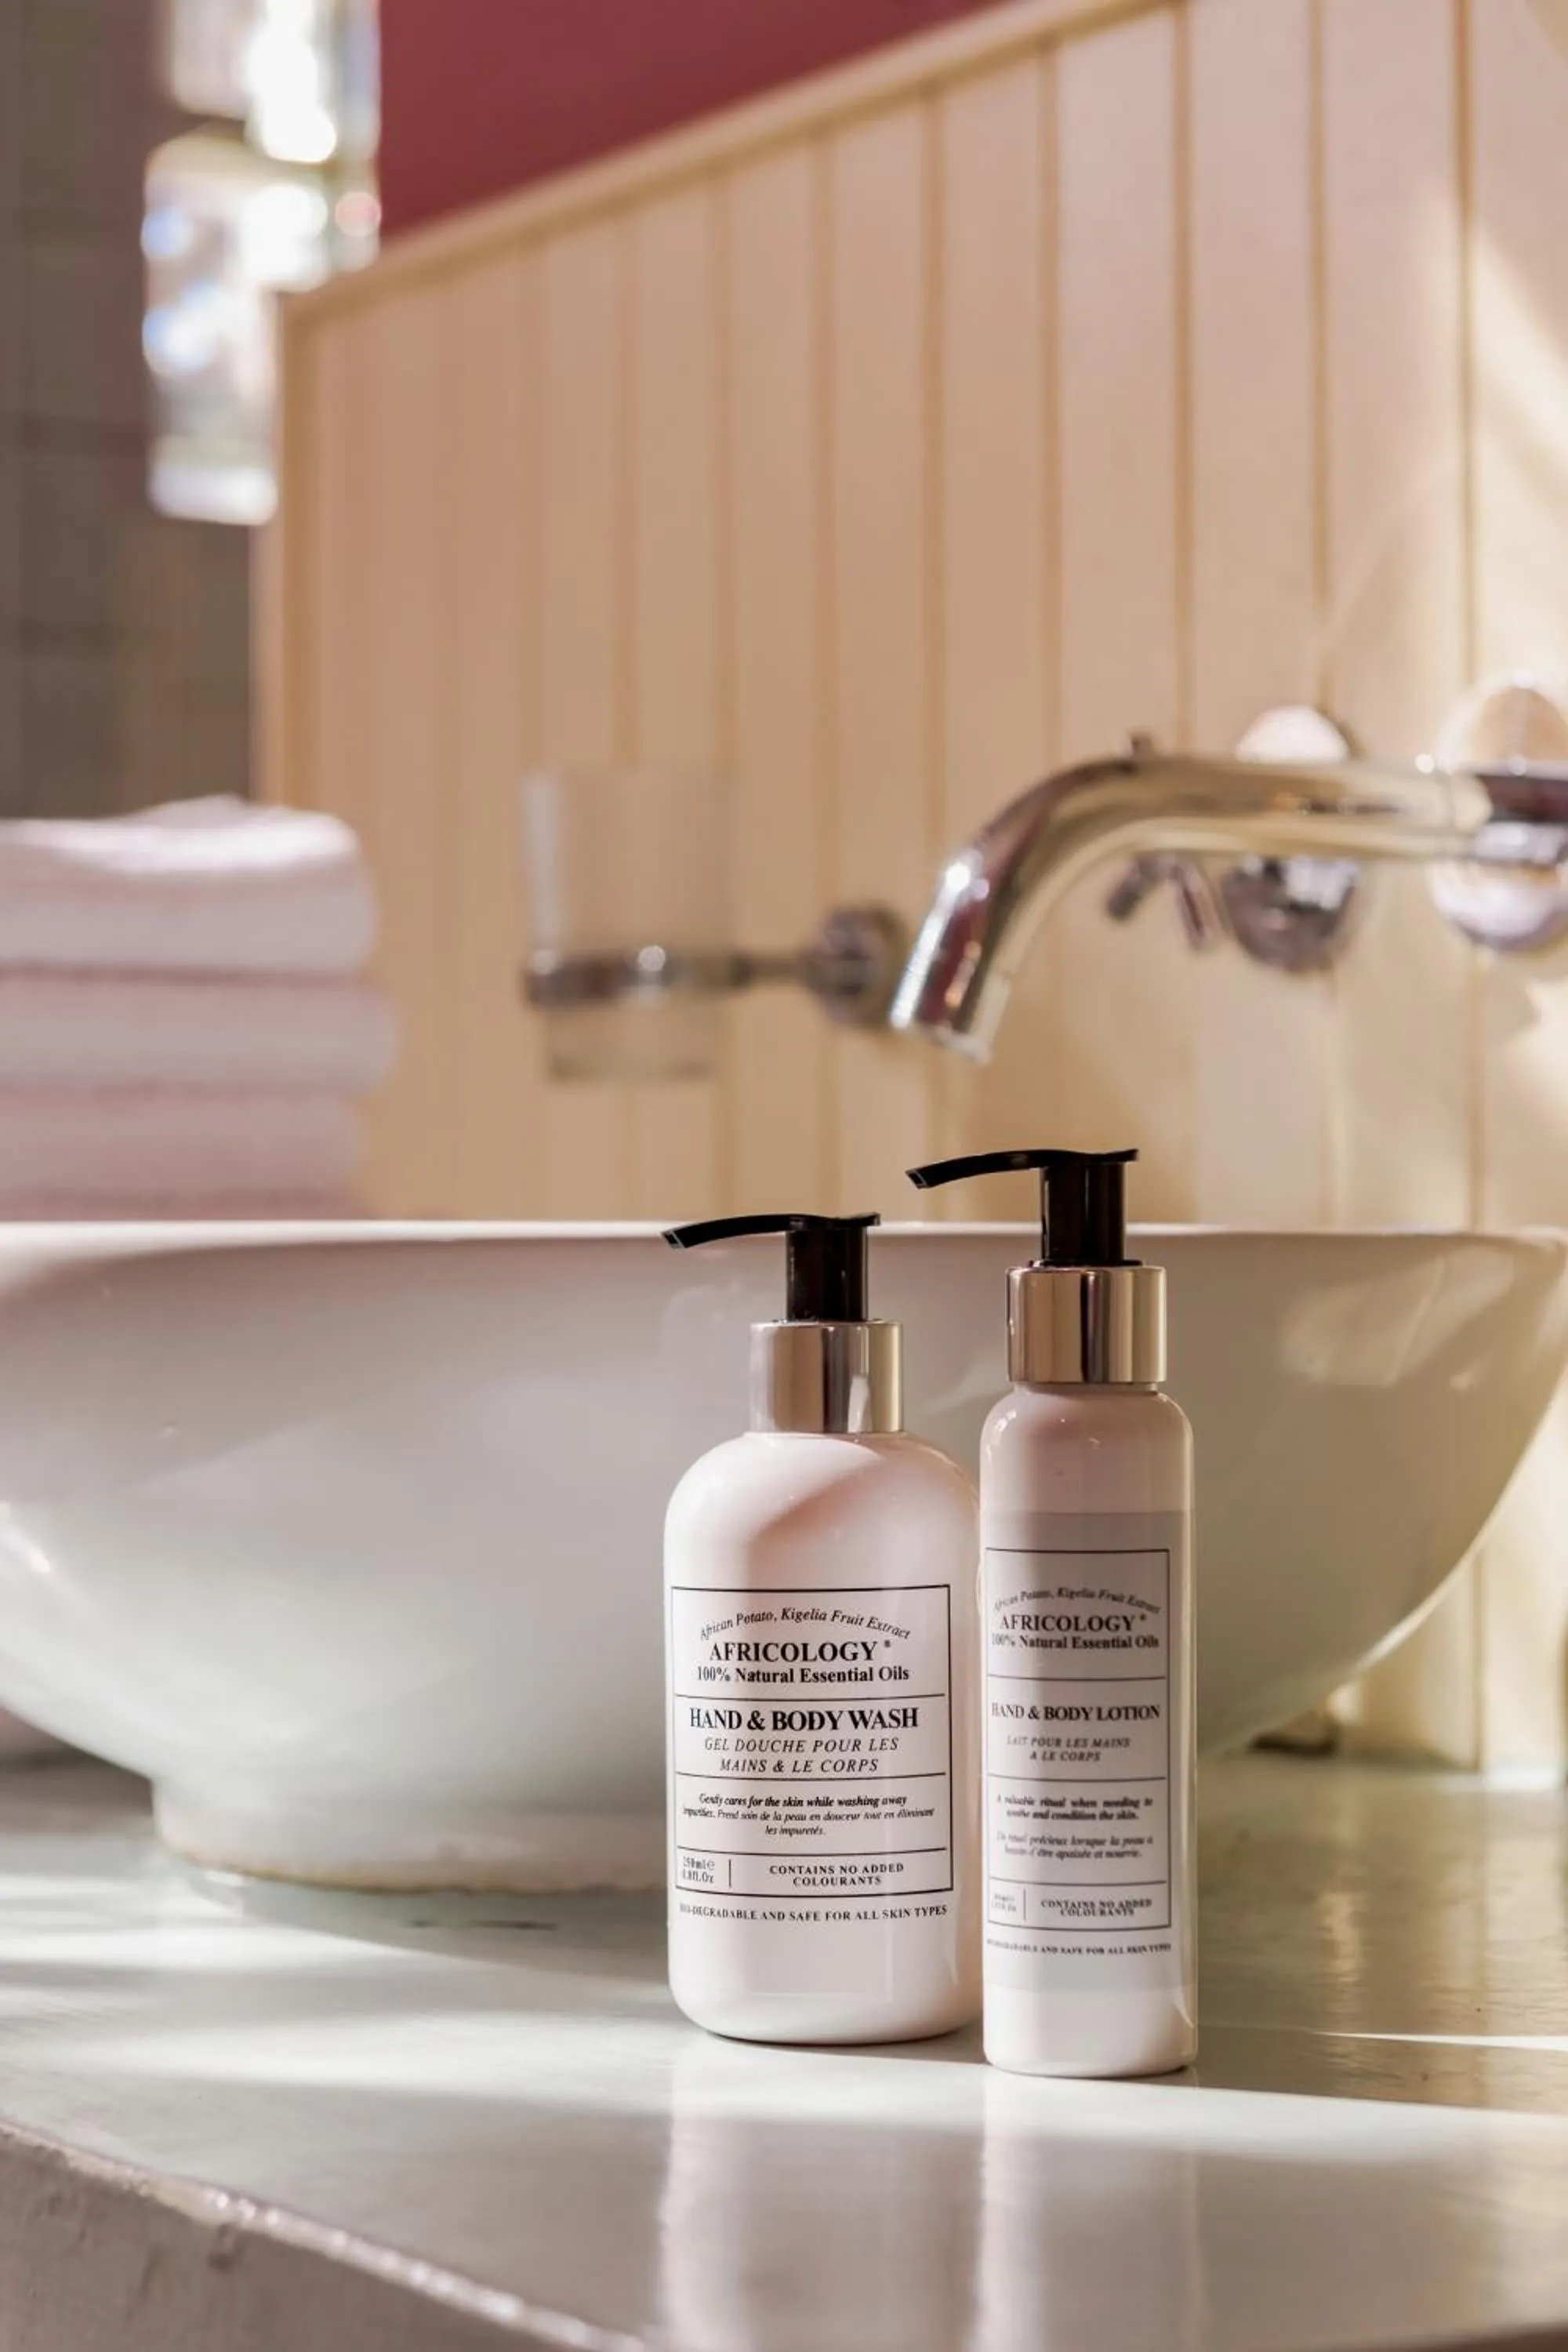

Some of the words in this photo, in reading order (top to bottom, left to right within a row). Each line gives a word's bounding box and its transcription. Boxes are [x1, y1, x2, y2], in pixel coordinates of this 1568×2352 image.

[701, 1618, 733, 1640] African
[735, 1611, 777, 1625] Potato,
[781, 1607, 826, 1623] Kigelia
[830, 1610, 863, 1626] Fruit
[866, 1617, 911, 1639] Extract
[1000, 1614, 1135, 1632] AFRICOLOGY
[1019, 1634, 1067, 1648] Natural
[1072, 1635, 1131, 1649] Essential
[1134, 1634, 1159, 1647] Oils
[710, 1641, 877, 1662] AFRICOLOGY
[698, 1666, 731, 1682] 100%
[735, 1667, 794, 1683] Natural
[800, 1666, 873, 1683] Essential
[879, 1665, 909, 1681] Oils
[992, 1702, 1025, 1719] HAND
[1028, 1705, 1040, 1720] &
[1044, 1705, 1094, 1721] BODY
[1097, 1704, 1160, 1721] LOTION
[690, 1708, 742, 1730] HAND
[747, 1711, 766, 1731] &
[771, 1711, 844, 1731] BODY
[848, 1708, 918, 1730] WASH
[705, 1738, 730, 1751] GEL
[735, 1739, 806, 1753] DOUCHE
[813, 1739, 862, 1753] POUR
[869, 1737, 898, 1751] LES
[1030, 1737, 1062, 1748] POUR
[1065, 1737, 1089, 1748] LES
[1091, 1737, 1131, 1748] MAINS
[1060, 1751, 1102, 1762] CORPS
[720, 1759, 767, 1773] MAINS
[772, 1759, 785, 1773] &
[792, 1759, 813, 1773] LE
[821, 1759, 879, 1773] CORPS
[724, 1796, 746, 1806] cares
[747, 1795, 763, 1808] for
[764, 1796, 780, 1806] the
[782, 1795, 804, 1807] skin
[807, 1796, 834, 1807] while
[837, 1795, 880, 1808] washing
[881, 1796, 907, 1806] away
[760, 1811, 770, 1820] de
[773, 1811, 782, 1821] la
[769, 1865, 835, 1875] CONTAINS
[840, 1865, 858, 1875] NO
[862, 1862, 904, 1874] ADDED
[793, 1876, 882, 1886] COLOURANTS
[1040, 1899, 1095, 1909] CONTAINS
[1100, 1899, 1115, 1909] NO
[760, 1910, 785, 1921] AND
[789, 1910, 821, 1921] SAFE
[825, 1910, 851, 1921] FOR
[855, 1910, 879, 1920] ALL
[882, 1907, 910, 1919] SKIN
[914, 1904, 948, 1918] TYPES
